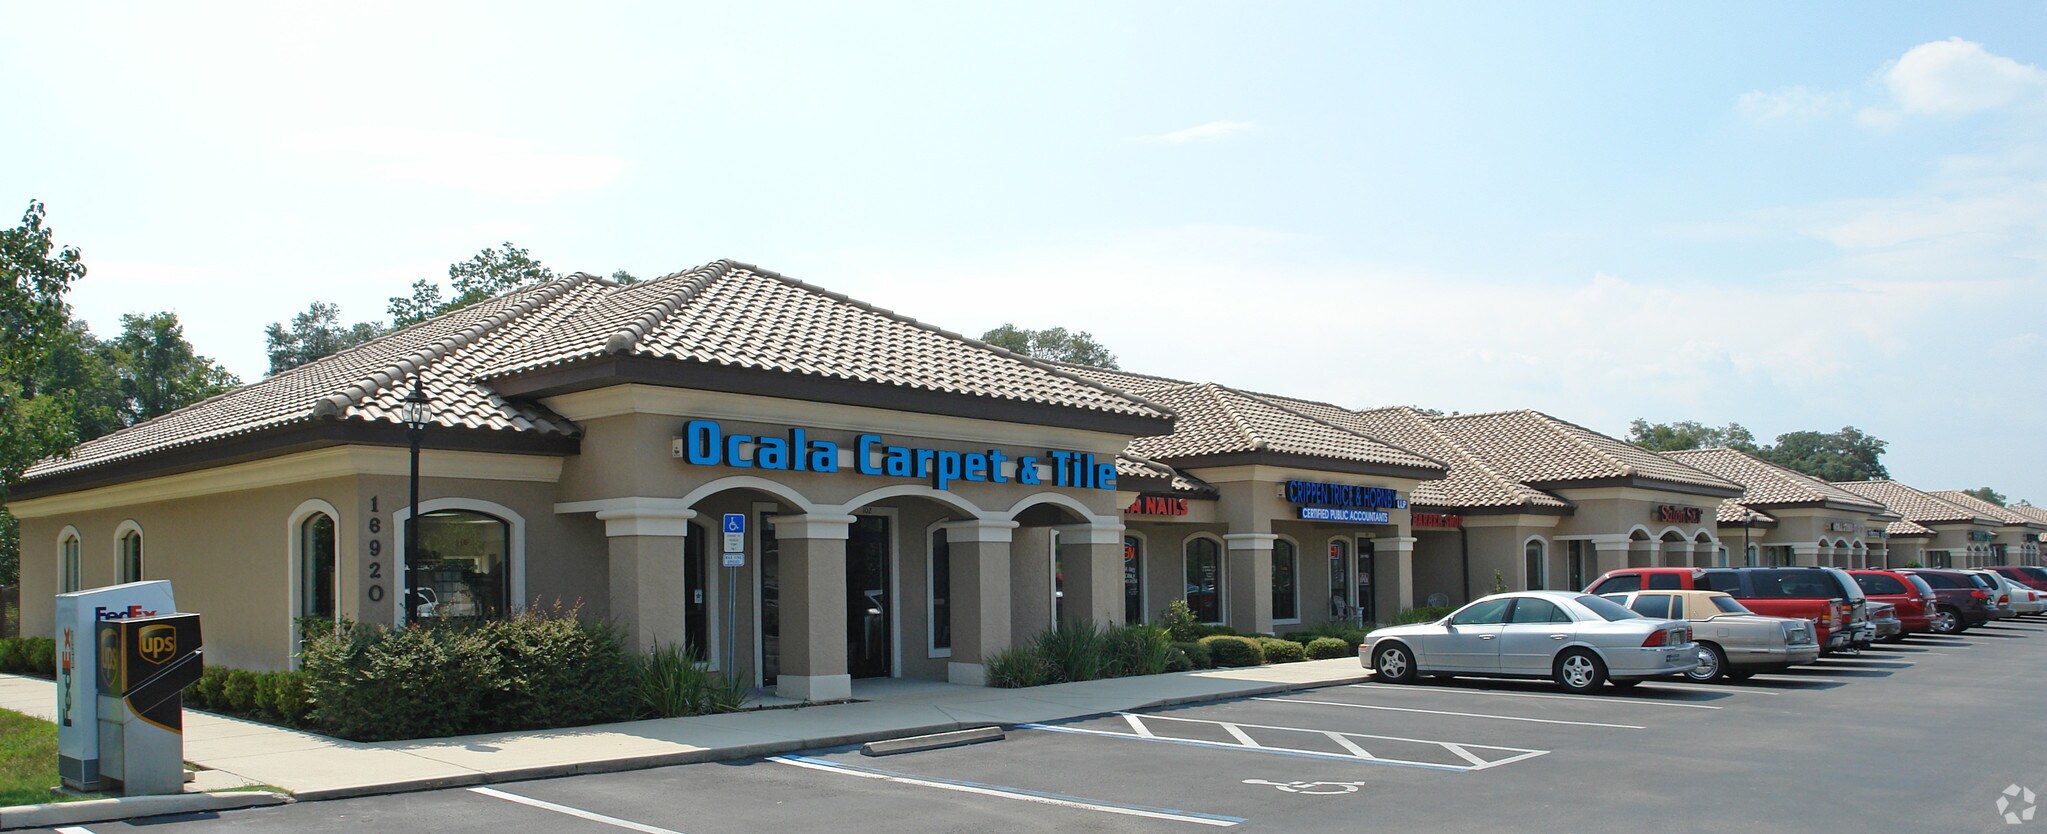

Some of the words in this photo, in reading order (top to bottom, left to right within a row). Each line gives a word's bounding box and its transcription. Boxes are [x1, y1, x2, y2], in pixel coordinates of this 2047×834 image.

[683, 420, 838, 473] Ocala
[854, 434, 1008, 490] Carpet
[1016, 456, 1041, 485] &
[1048, 451, 1116, 490] Tile
[1145, 496, 1188, 516] NAILS
[1289, 481, 1328, 504] CRIPPEN
[1331, 484, 1353, 507] TRICE
[1355, 486, 1362, 507] &
[1364, 487, 1397, 509] HORNBY
[1302, 508, 1330, 519] CERTIFIED
[1330, 510, 1348, 520] PUBLIC
[1349, 511, 1388, 522] ACCOUNTANTS
[367, 495, 384, 602] 16920
[141, 636, 174, 658] ups
[62, 626, 72, 727] FedEx
